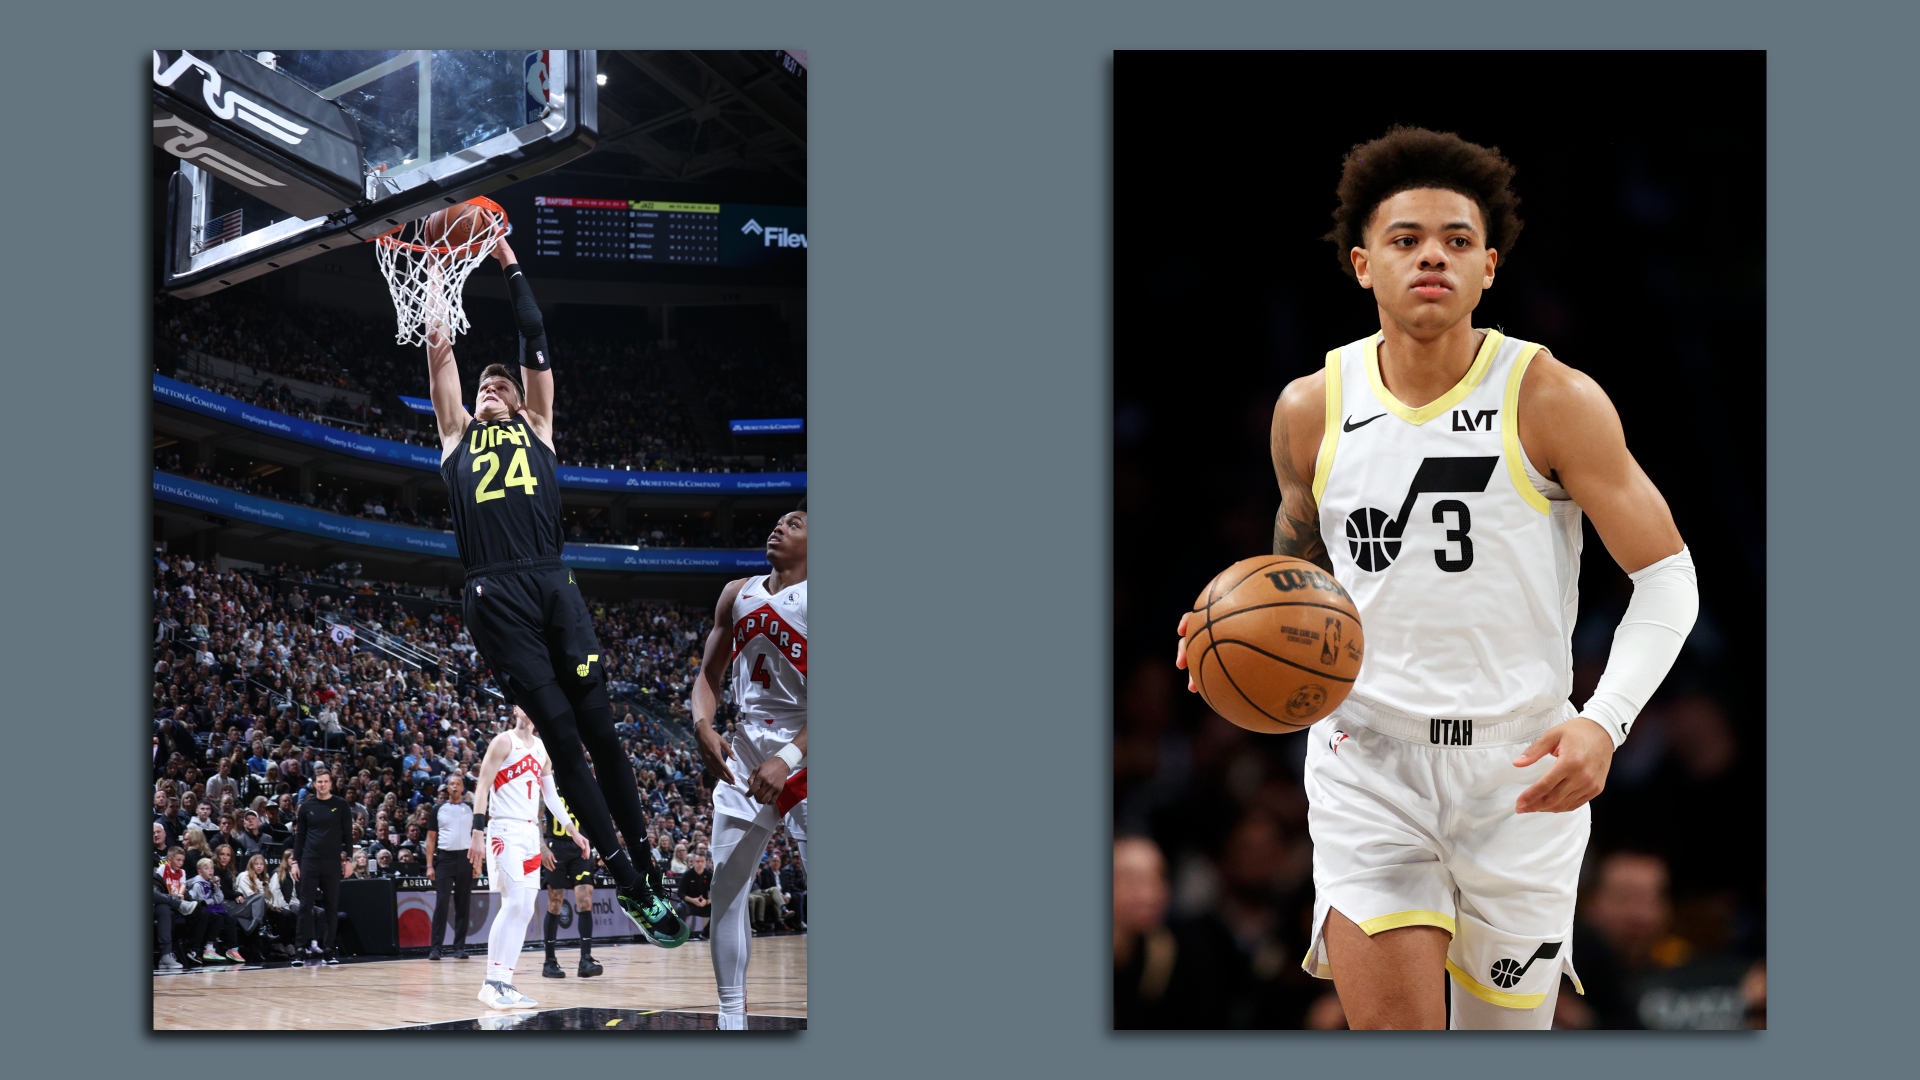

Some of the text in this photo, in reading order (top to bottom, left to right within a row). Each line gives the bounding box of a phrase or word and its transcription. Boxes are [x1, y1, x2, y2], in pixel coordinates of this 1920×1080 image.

[547, 198, 573, 206] RAPTORS
[153, 384, 185, 399] ORETON
[242, 412, 291, 432] Employee Benefits
[1452, 409, 1498, 432] LVT
[325, 435, 348, 448] Property
[352, 442, 376, 454] Casualty
[470, 423, 531, 454] UTAH
[411, 454, 428, 463] Surety
[472, 448, 538, 503] 24
[563, 474, 609, 484] Cyber Insurance
[153, 483, 176, 494] RETON
[737, 481, 766, 489] Employee
[235, 503, 284, 520] Employee Benefits
[319, 521, 342, 533] Property
[346, 527, 371, 539] Casualty
[1432, 500, 1474, 573] 3
[406, 537, 424, 547] Surety
[429, 540, 447, 549] Bonds
[1264, 568, 1353, 605] Wilso
[750, 653, 771, 689] 4
[1430, 718, 1473, 746] UTAH
[526, 780, 532, 799] 1
[594, 916, 613, 926] kies
